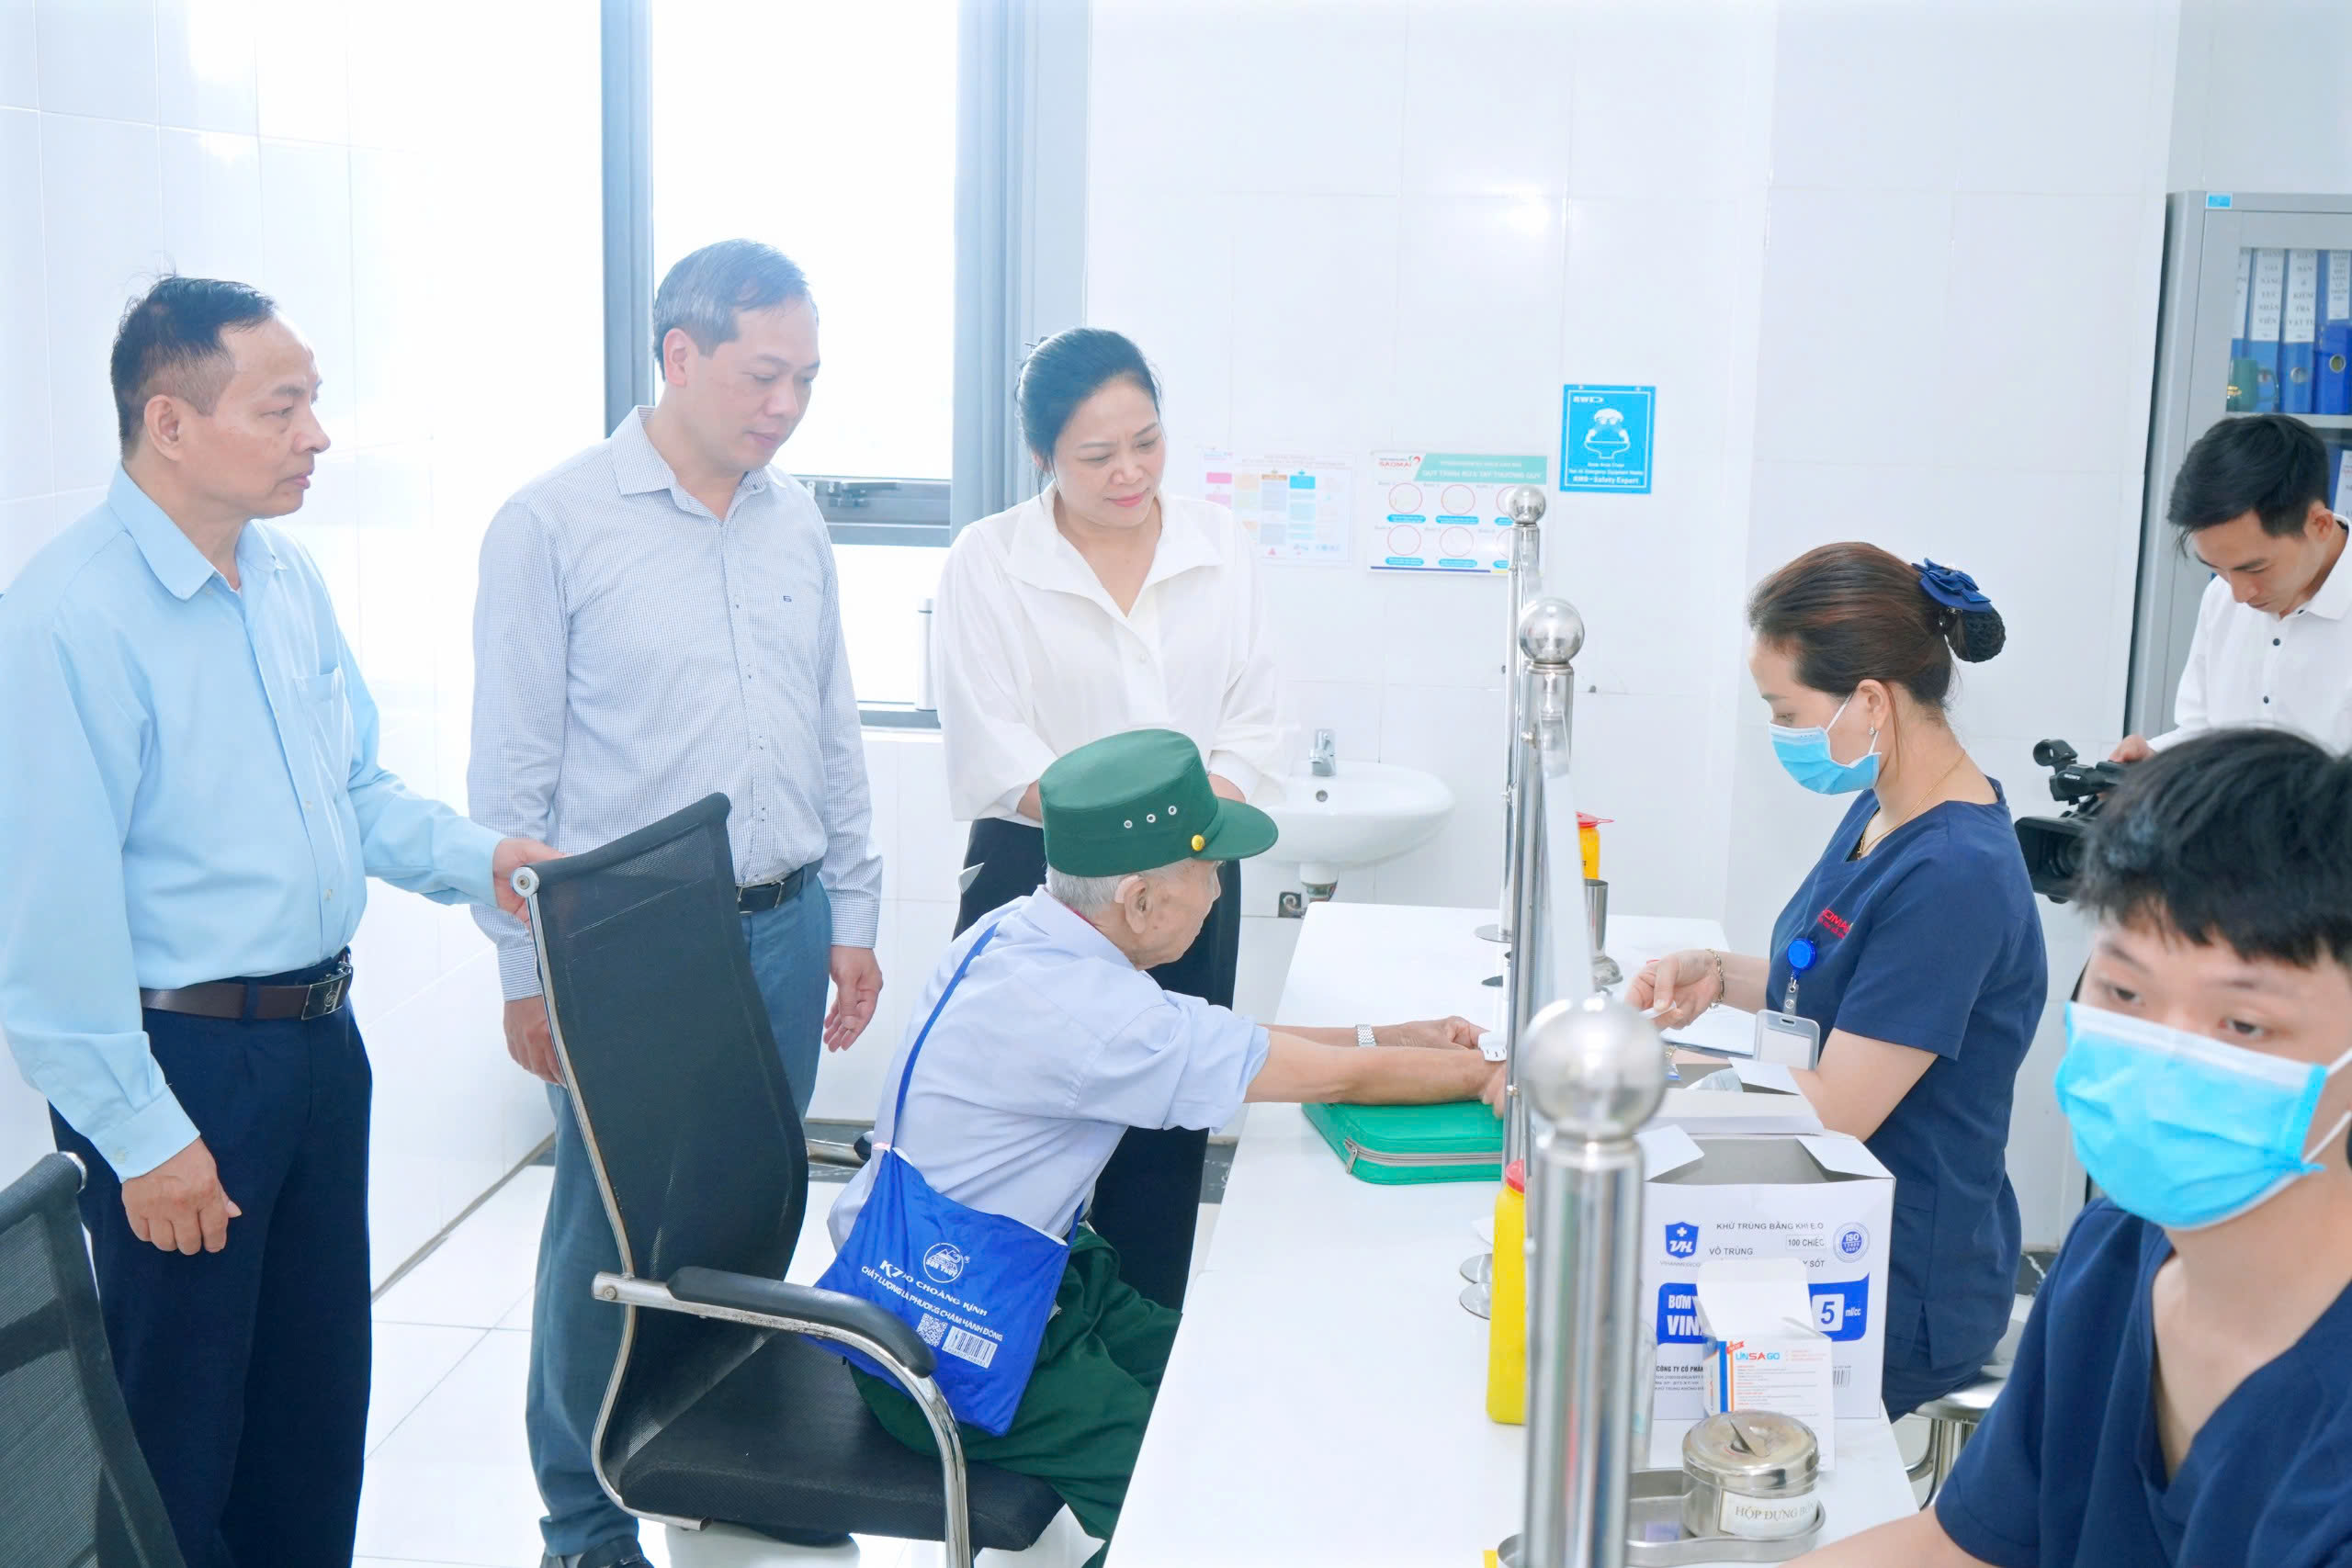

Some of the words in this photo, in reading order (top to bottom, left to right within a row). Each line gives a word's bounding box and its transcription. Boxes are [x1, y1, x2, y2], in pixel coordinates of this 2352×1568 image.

[1737, 1222, 1766, 1230] TRÙNG
[1846, 1233, 1860, 1242] ISO
[1709, 1247, 1722, 1256] VÔ
[1724, 1246, 1753, 1256] TRÙNG
[1809, 1258, 1825, 1268] SỐT
[1668, 1293, 1691, 1310] BƠM
[963, 1301, 988, 1317] KÍNH
[1821, 1301, 1835, 1325] 5
[1736, 1506, 1761, 1520] HỘP
